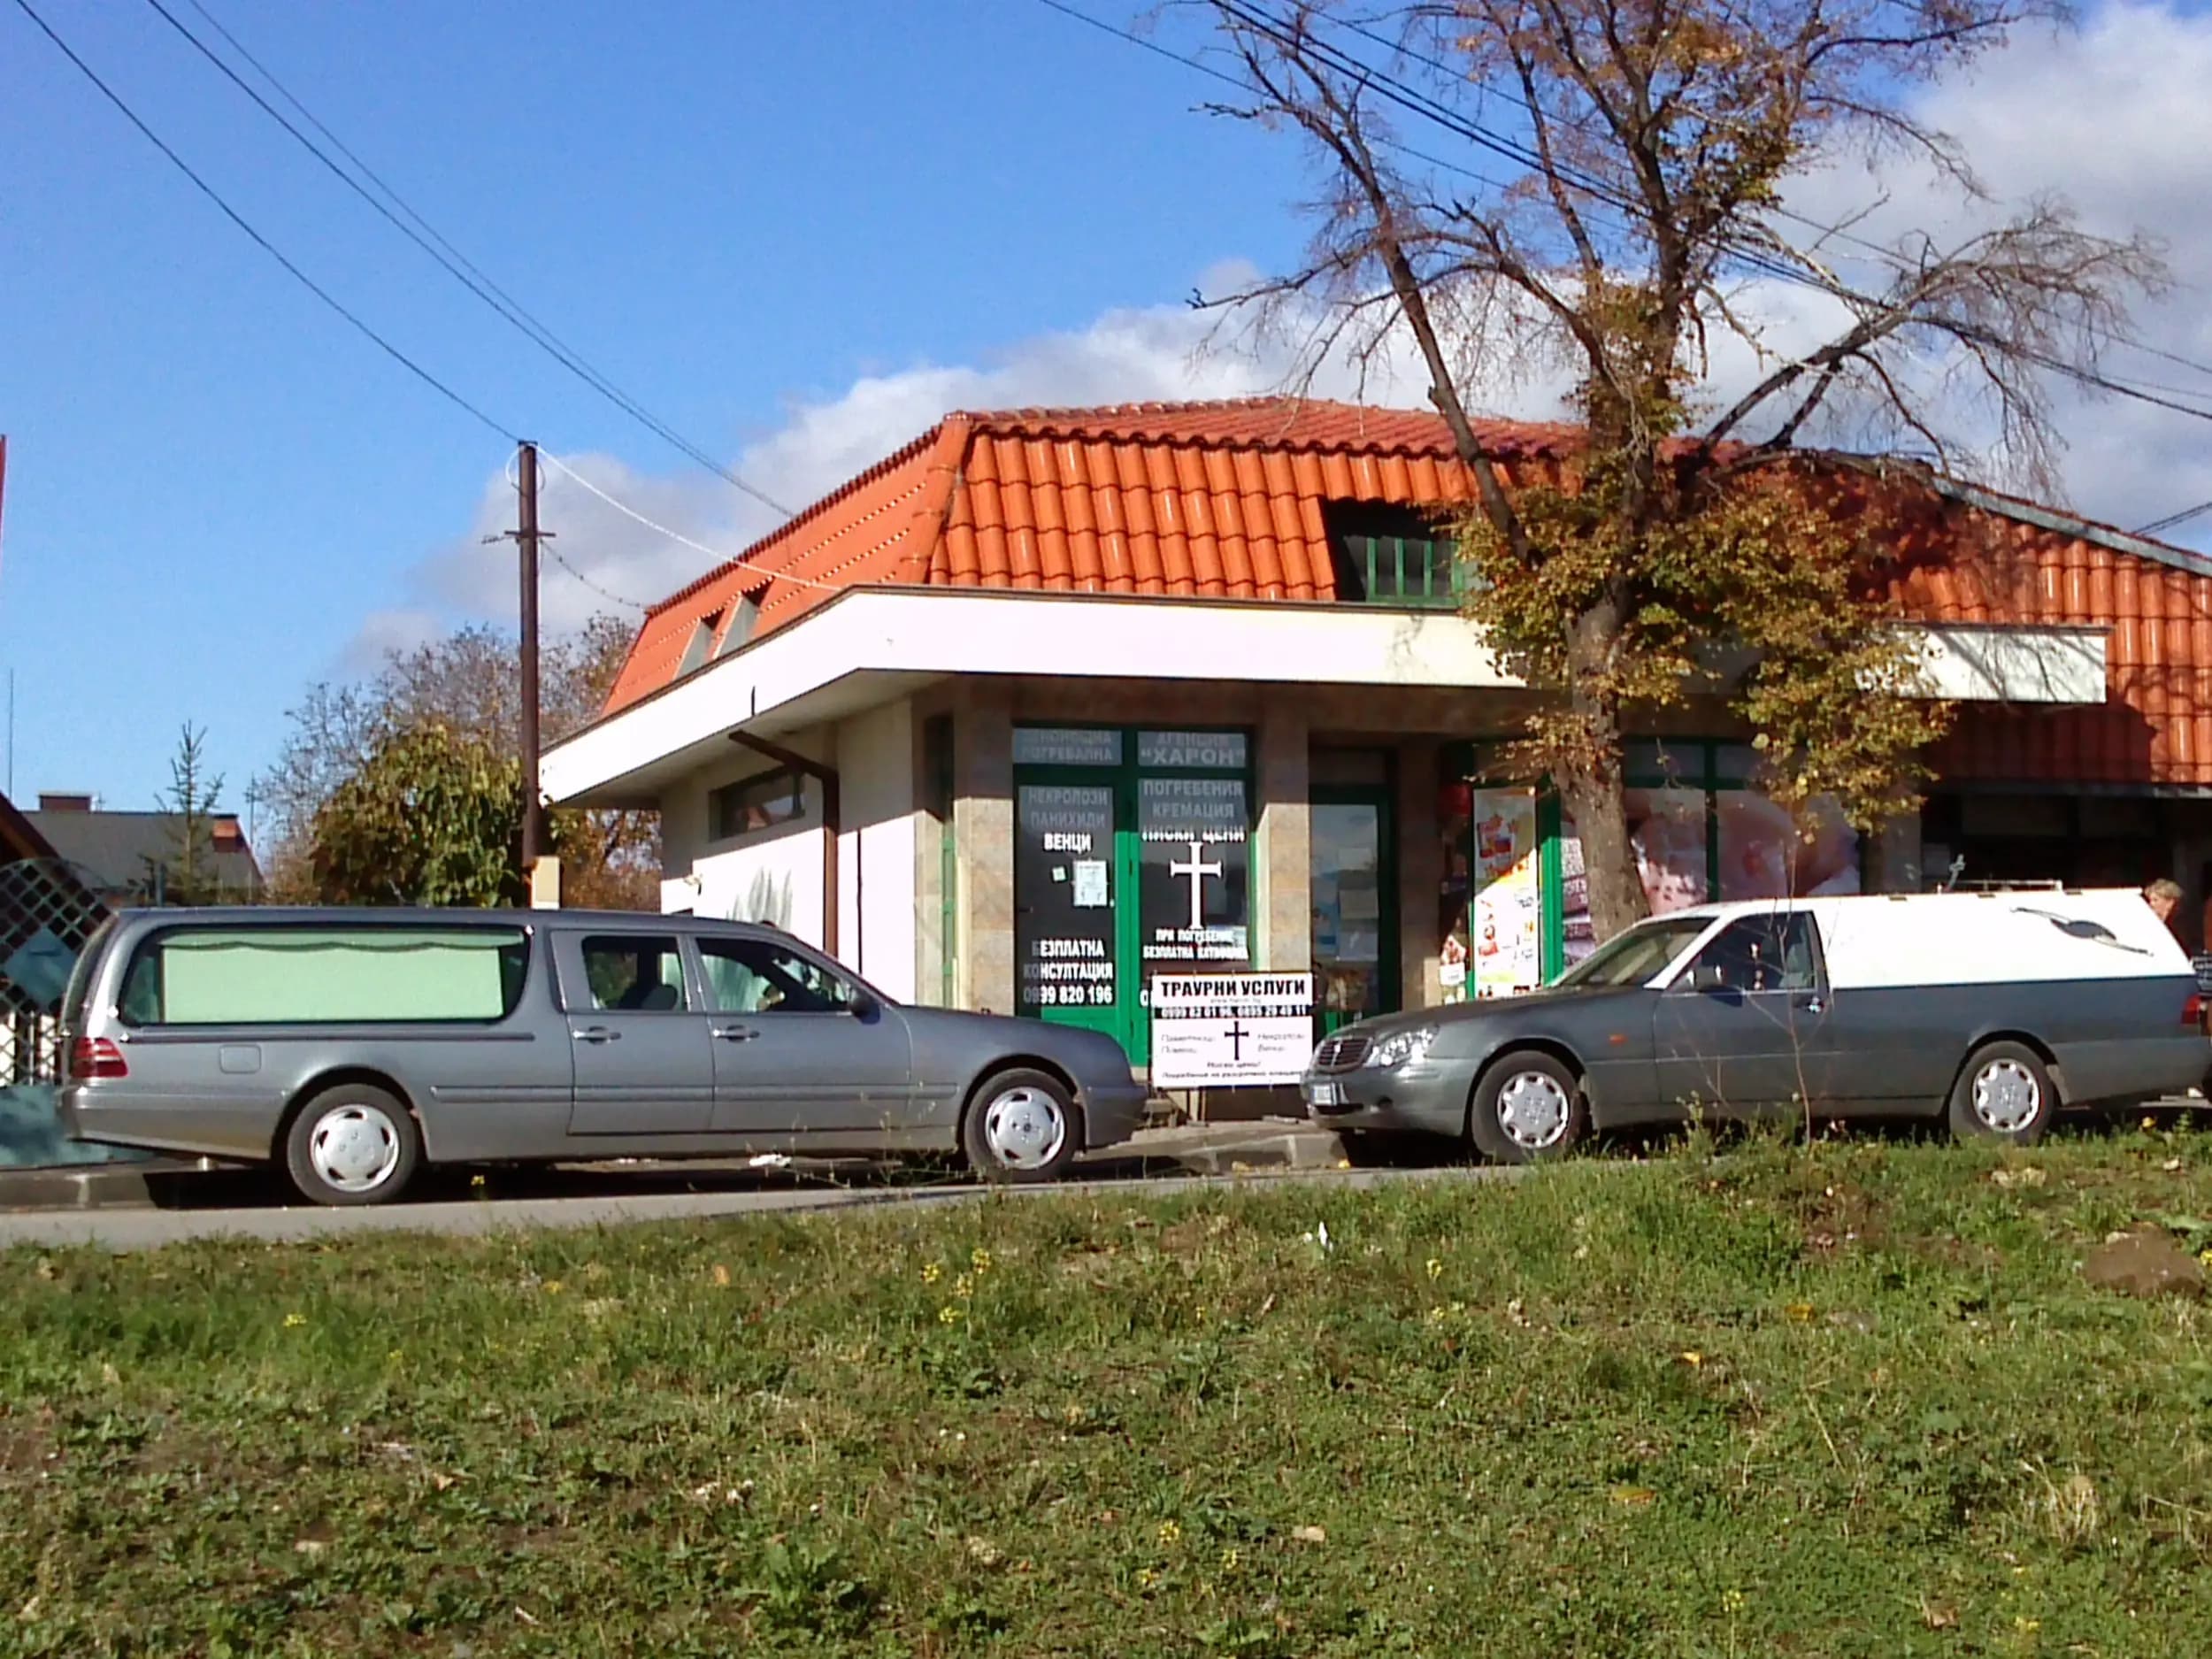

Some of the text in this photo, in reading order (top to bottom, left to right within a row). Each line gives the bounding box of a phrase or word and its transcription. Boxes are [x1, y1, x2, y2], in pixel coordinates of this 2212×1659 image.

[1143, 780, 1242, 796] ПОГРЕБЕНИЯ
[1030, 811, 1106, 830] ПАНИХИДИ
[1153, 803, 1234, 820] КРЕМАЦИЯ
[1043, 833, 1092, 855] ВЕНЦИ
[1032, 939, 1105, 957] БЕЗПЛАТНА
[1024, 962, 1113, 983] КОНСУЛТАЦИЯ
[1059, 984, 1085, 1004] 820
[1087, 984, 1113, 1004] 196
[1161, 979, 1305, 997] ТРАУРНИ УСЛУГИ
